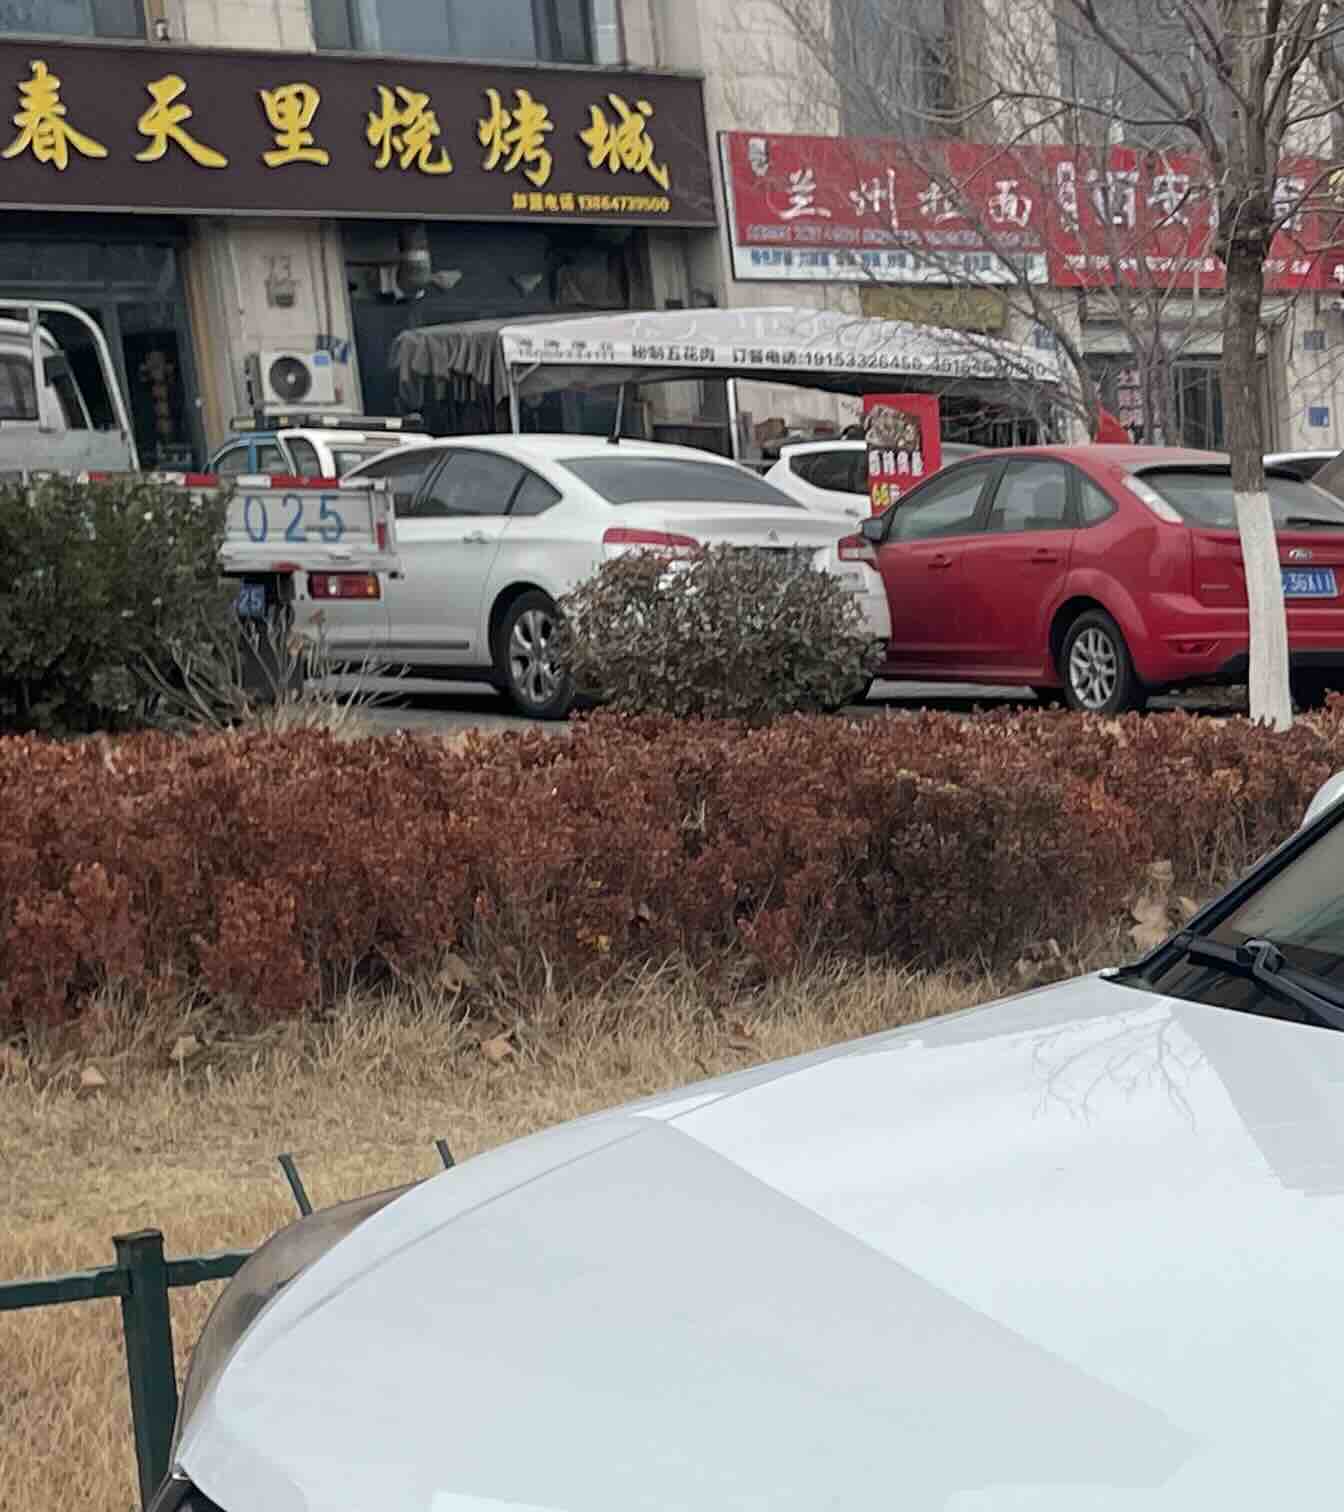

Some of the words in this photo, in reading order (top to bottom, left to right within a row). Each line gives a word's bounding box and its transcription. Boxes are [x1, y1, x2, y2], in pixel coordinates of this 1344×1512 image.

[2, 58, 672, 190] 春天里烧烤城
[243, 494, 345, 543] 025
